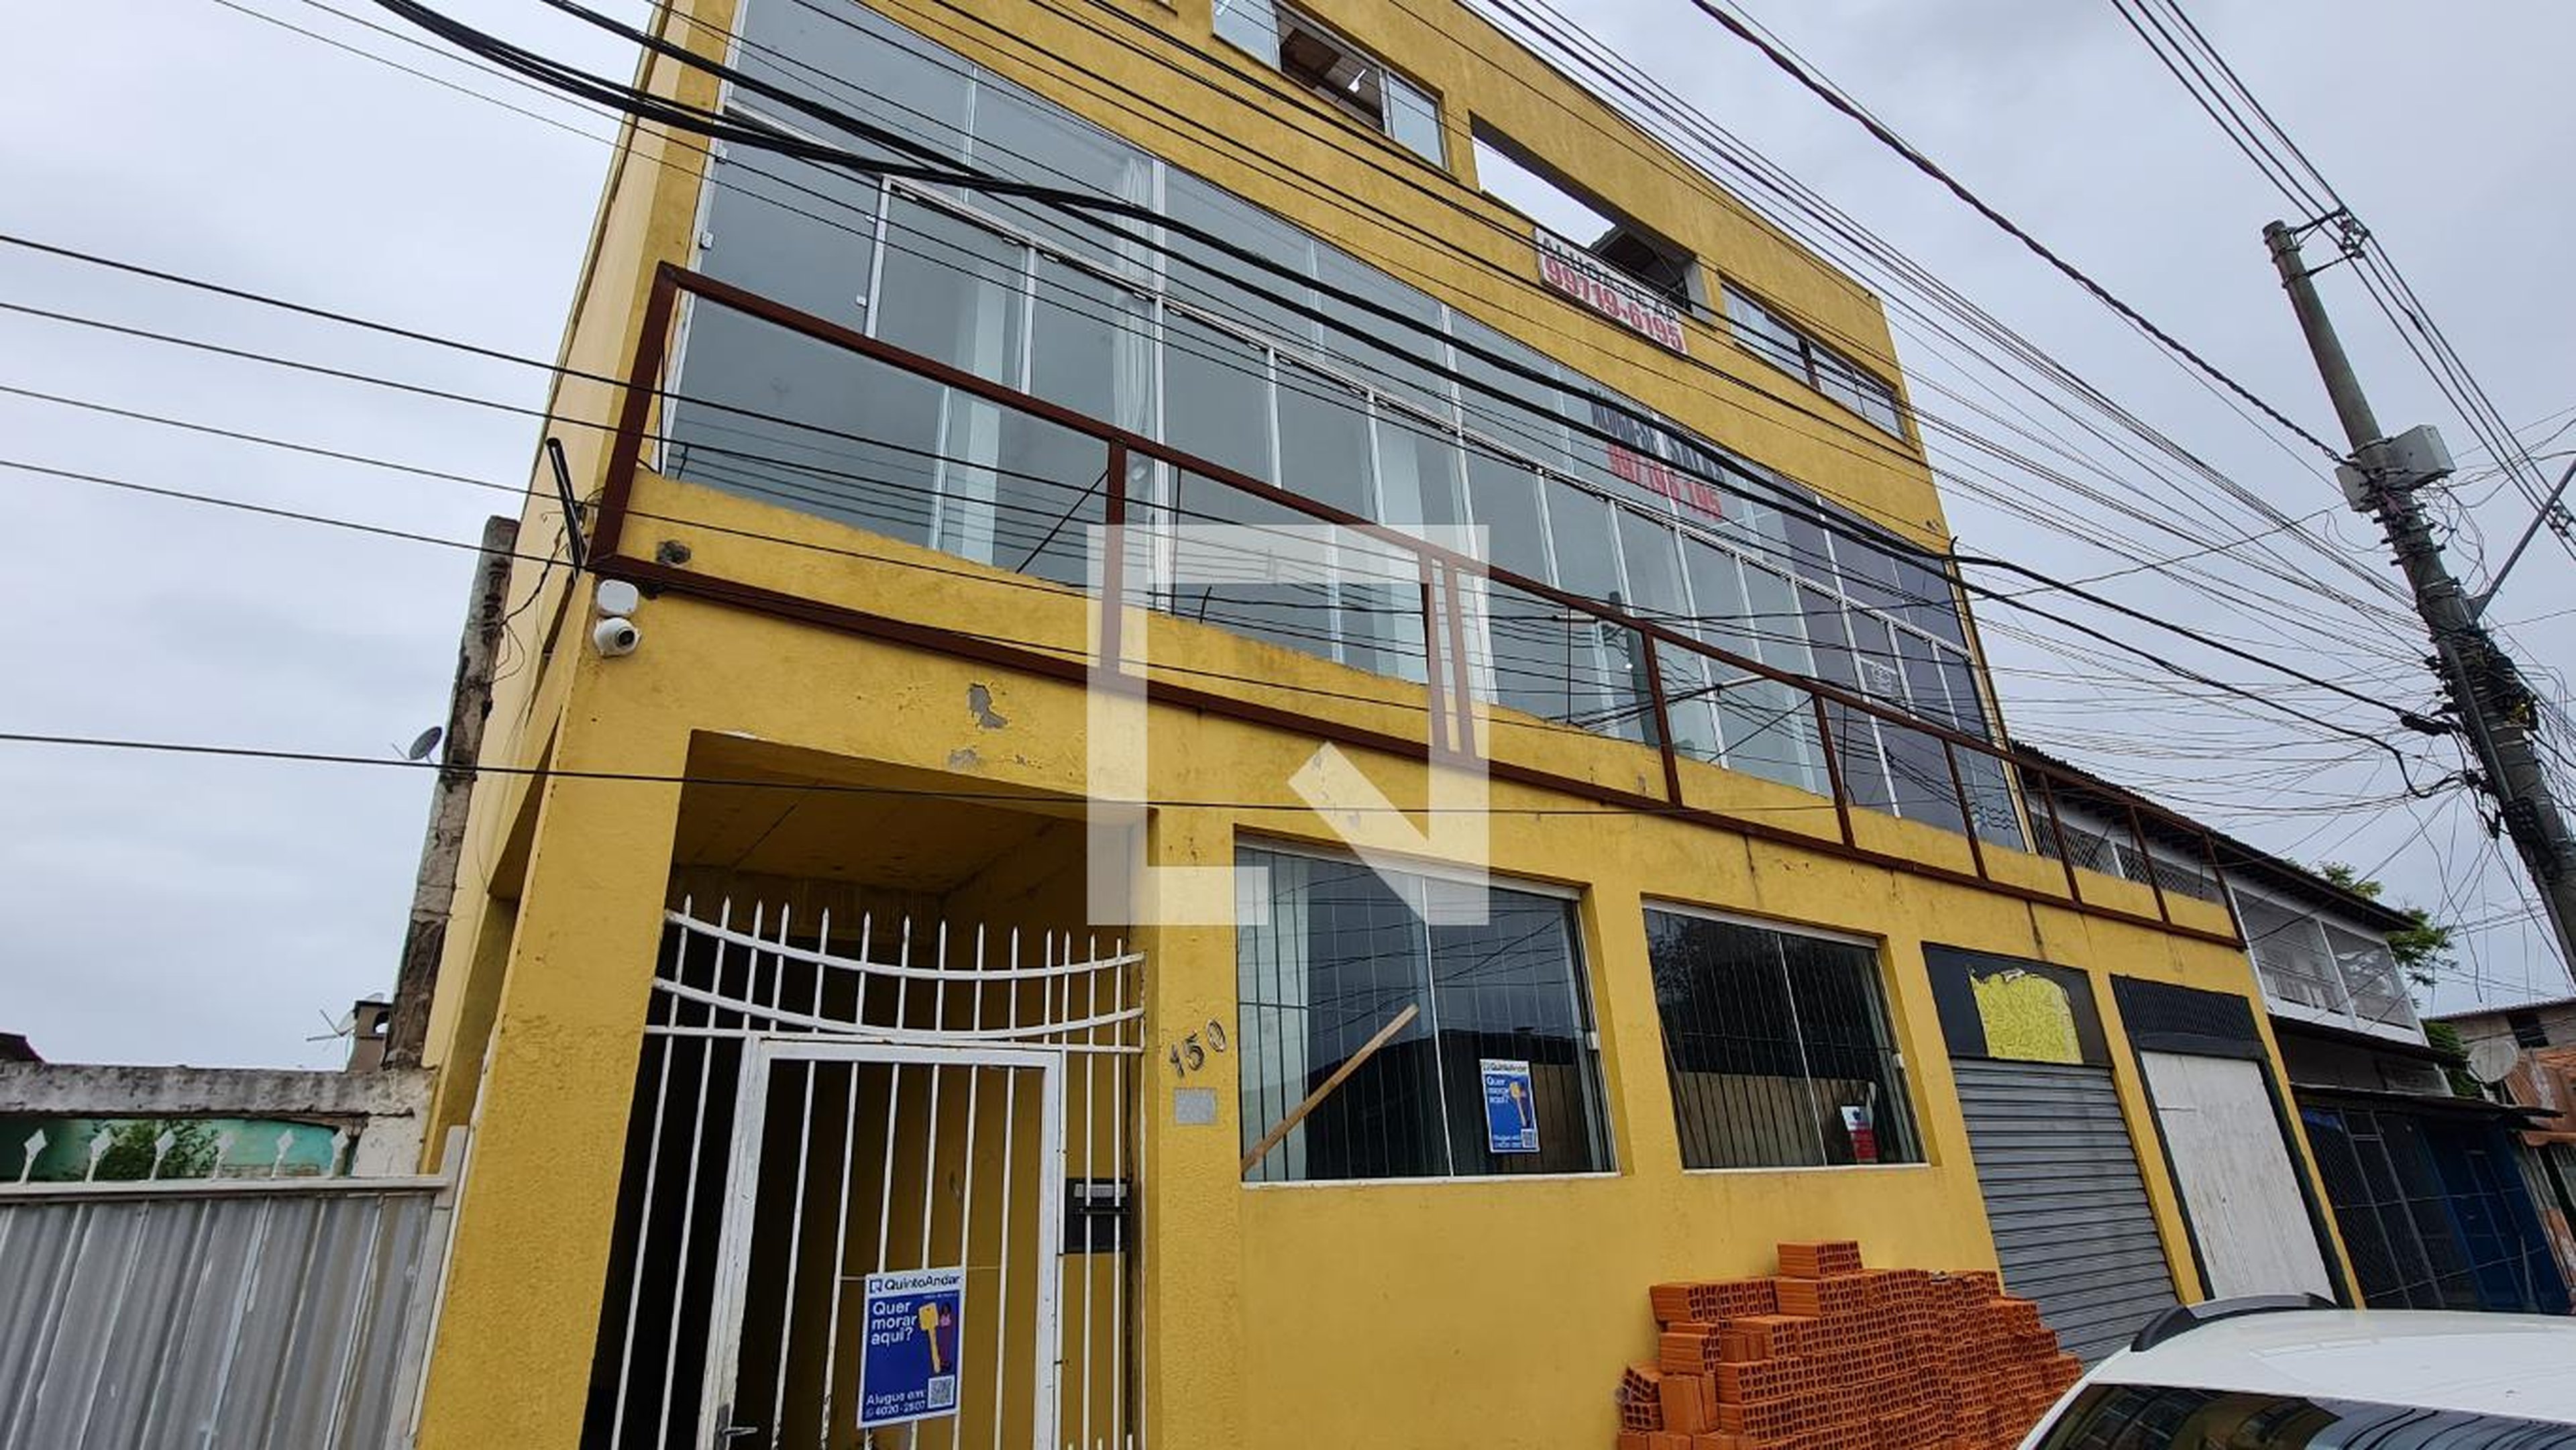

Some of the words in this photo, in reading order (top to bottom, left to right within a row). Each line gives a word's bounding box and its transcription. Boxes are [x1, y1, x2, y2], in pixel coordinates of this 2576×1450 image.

[1545, 256, 1684, 351] 99719-6195
[884, 1275, 961, 1291] QuintoAndar
[873, 1301, 911, 1316] Quer
[872, 1314, 918, 1331] morar
[871, 1327, 914, 1347] aqui?
[866, 1392, 905, 1406] Alugue
